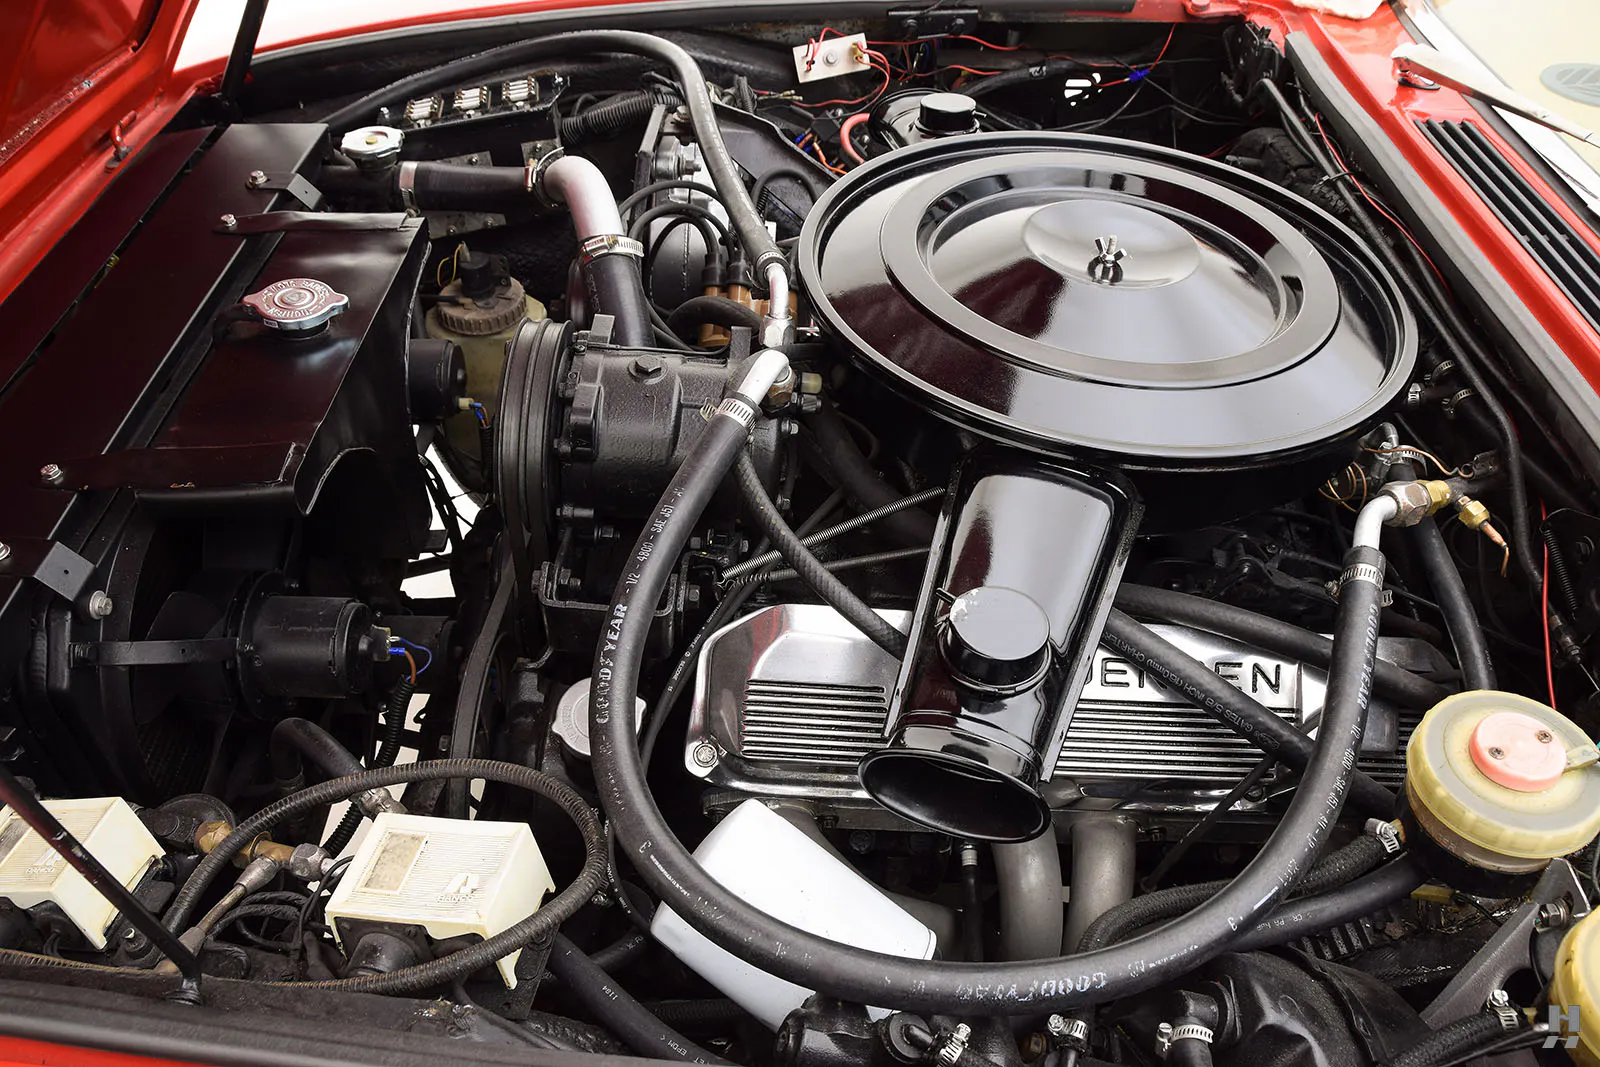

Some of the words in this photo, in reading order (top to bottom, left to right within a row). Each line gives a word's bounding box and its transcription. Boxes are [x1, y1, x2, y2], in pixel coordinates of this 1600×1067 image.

[650, 515, 667, 534] SAE
[1221, 708, 1254, 734] GATES
[1332, 775, 1346, 795] SAE
